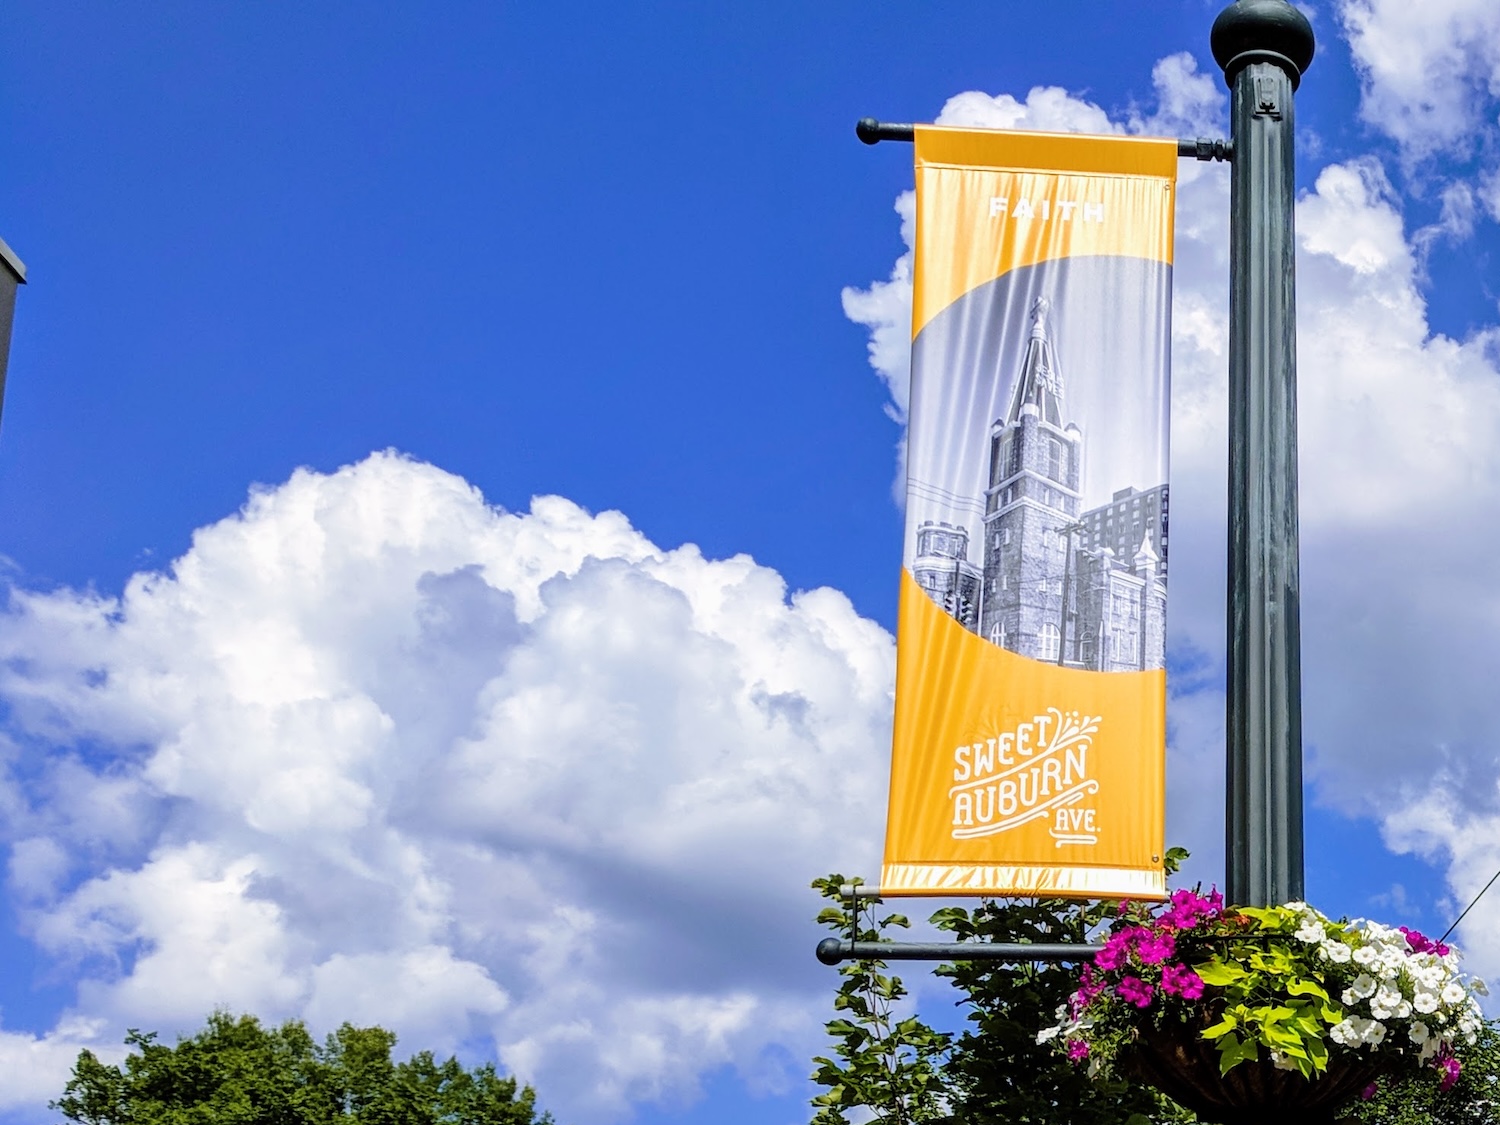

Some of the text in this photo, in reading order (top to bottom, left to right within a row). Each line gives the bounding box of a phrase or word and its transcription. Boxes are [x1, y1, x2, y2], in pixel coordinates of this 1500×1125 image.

[989, 197, 1105, 223] FAITH
[953, 715, 1052, 782] SWEET
[952, 744, 1088, 825] AUBURN
